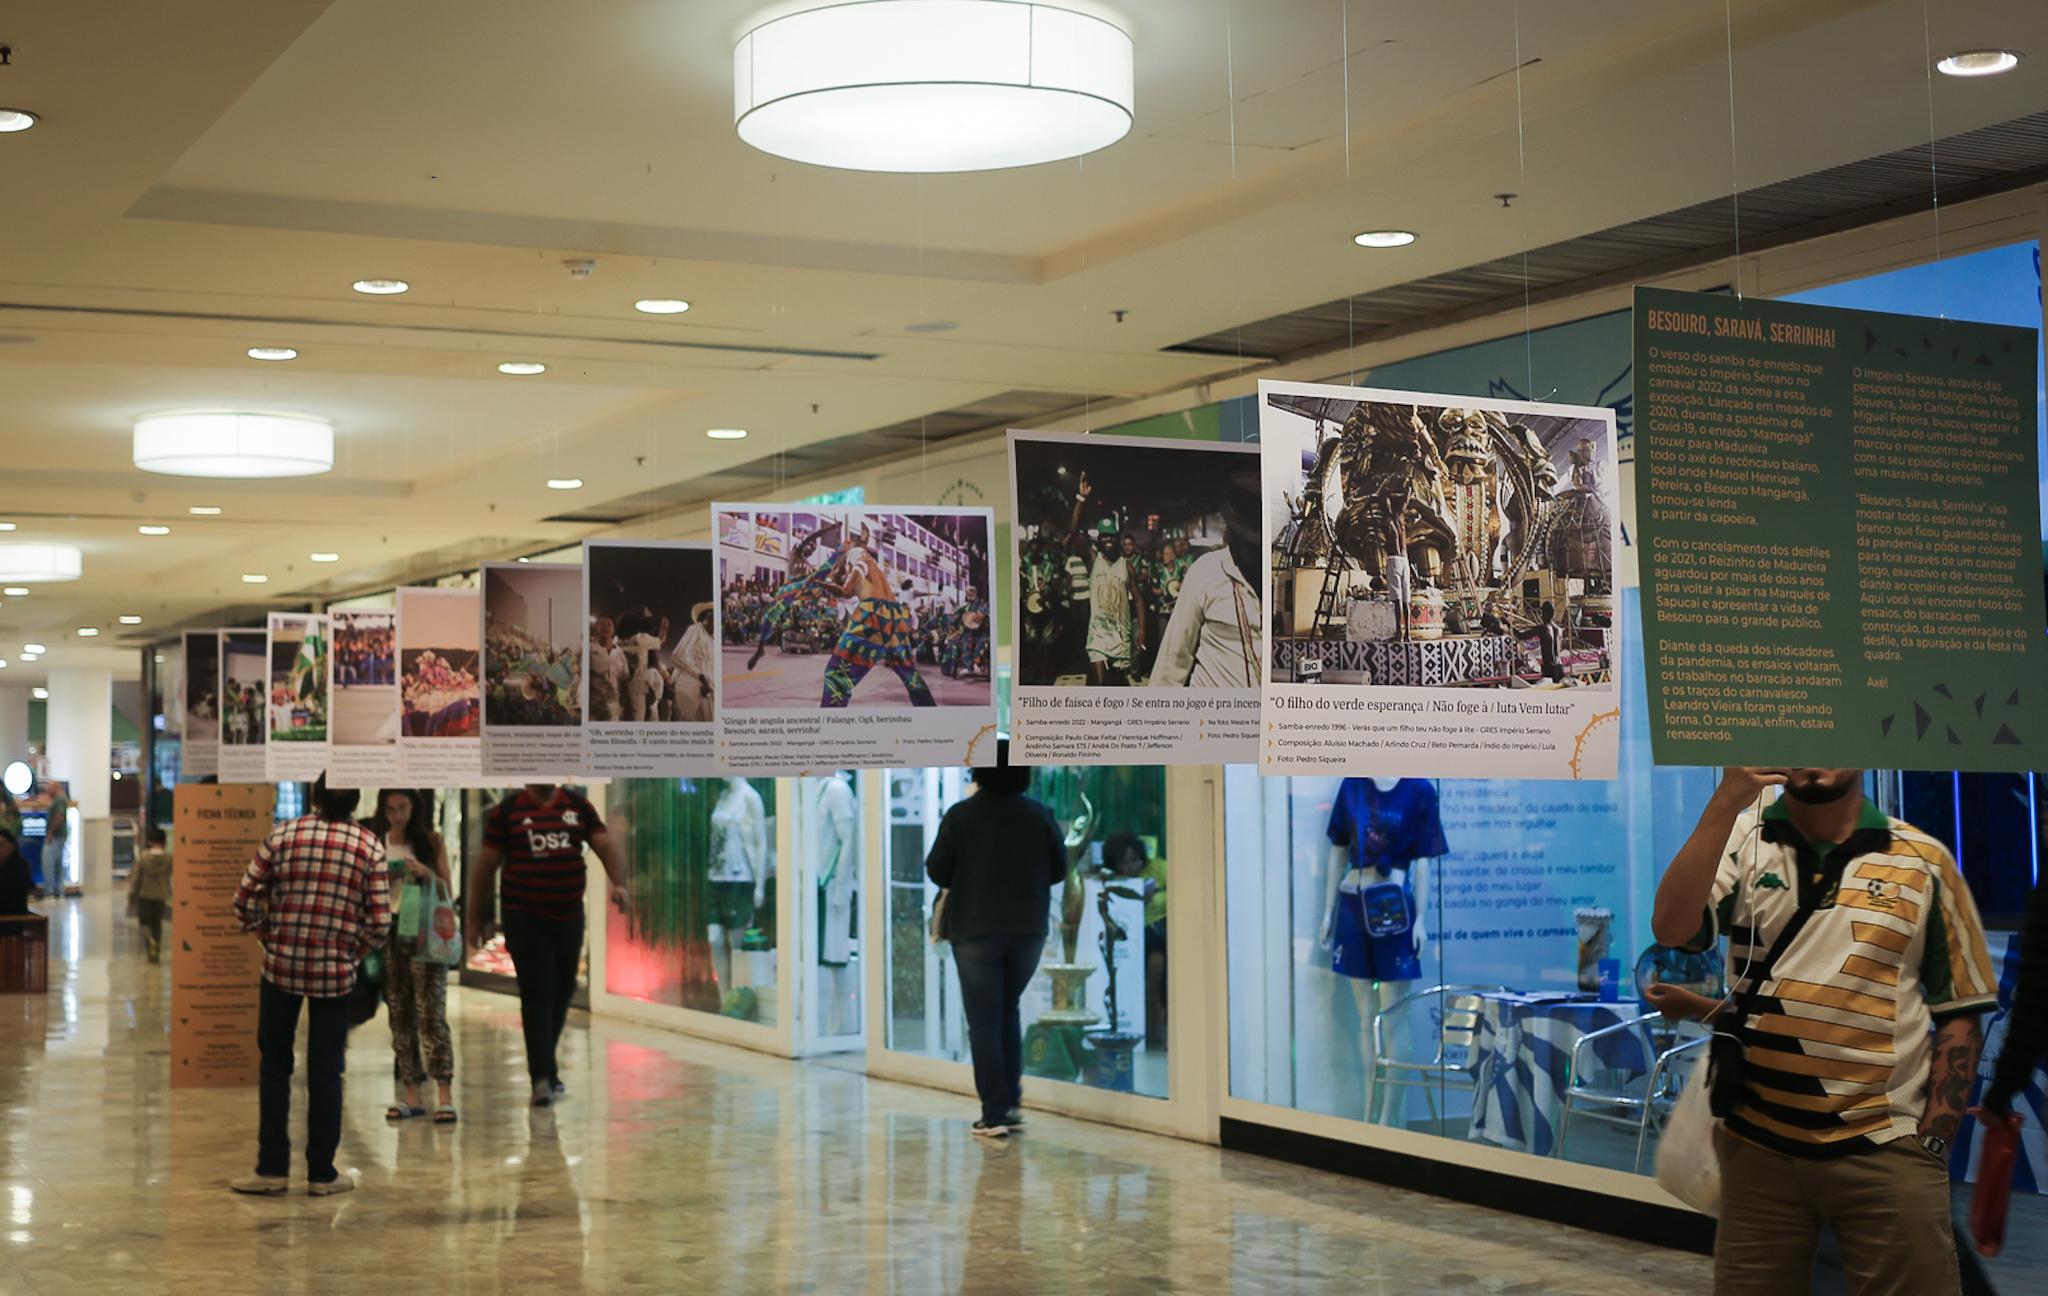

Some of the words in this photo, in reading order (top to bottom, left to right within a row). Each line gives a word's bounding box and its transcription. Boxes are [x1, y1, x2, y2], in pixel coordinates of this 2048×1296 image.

[1649, 310, 1711, 339] BESOURO,
[1715, 316, 1767, 344] SARAVÁ,
[1770, 321, 1836, 347] SERRINHA!
[1649, 346, 1658, 358] O
[1661, 350, 1690, 361] verso
[1692, 350, 1707, 363] do
[1709, 354, 1745, 366] samba
[1748, 355, 1761, 368] de
[1763, 359, 1801, 371] enredo
[1803, 363, 1823, 375] que
[1649, 363, 1697, 376] embalou
[1700, 368, 1707, 377] o
[1710, 366, 1751, 382] Império
[1754, 370, 1794, 385] Serrano
[1796, 377, 1810, 386] no
[1860, 592, 1884, 606] Aqui
[1886, 594, 1909, 605] você
[1912, 595, 1926, 606] vai
[1928, 597, 1975, 608] encontrar
[1978, 598, 2002, 610] fotos
[2004, 599, 2022, 611] dos
[1904, 607, 1917, 618] do
[1919, 608, 1962, 620] barracão
[1964, 612, 1981, 621] em
[1660, 639, 1696, 652] Diante
[1698, 641, 1712, 653] da
[1715, 642, 1749, 656] queda
[1752, 643, 1771, 655] dos
[1773, 644, 1834, 658] indicadores
[1863, 634, 1899, 648] desfile,
[1901, 636, 1914, 647] da
[1916, 638, 1962, 651] apuração
[1964, 641, 1970, 649] e
[1972, 639, 1985, 650] da
[1987, 639, 2011, 651] festa
[2013, 643, 2025, 652] na
[1660, 654, 1674, 666] da
[1678, 655, 1735, 669] pandemia,
[1737, 659, 1750, 668] os
[1752, 658, 1792, 670] ensaios
[1794, 659, 1843, 673] voltaram,
[1661, 671, 1674, 680] os
[1677, 669, 1728, 682] trabalhos
[1730, 673, 1744, 683] no
[1746, 671, 1793, 684] barracão
[1795, 673, 1842, 686] andaram
[1867, 676, 1888, 688] Axé!
[1662, 686, 1670, 695] e
[1672, 686, 1685, 695] os
[1687, 684, 1720, 699] traços
[1723, 685, 1737, 697] do
[1739, 687, 1808, 699] carnavalesco
[1050, 697, 1062, 707] de
[1065, 697, 1093, 708] faísca
[1095, 697, 1101, 708] é
[1103, 697, 1124, 710] fogo
[1132, 697, 1143, 708] Se
[1145, 697, 1170, 708] entra
[1173, 700, 1185, 708] no
[1187, 697, 1207, 710] jogo
[1208, 697, 1214, 708] é
[1216, 700, 1232, 710] pra
[1288, 697, 1313, 709] filho
[1316, 698, 1330, 710] do
[1333, 698, 1364, 711] verde
[1367, 702, 1423, 714] esperança
[1433, 700, 1454, 712] Não
[1457, 700, 1479, 716] foge
[1497, 701, 1517, 714] luta
[1519, 702, 1542, 714] Vem
[1664, 698, 1709, 711] Leandro
[1711, 699, 1742, 712] Vieira
[1744, 700, 1776, 713] foram
[1778, 702, 1832, 716] ganhando
[748, 715, 758, 725] de
[760, 715, 785, 727] angola
[786, 715, 820, 724] ancestral
[876, 714, 912, 723] berimbau
[1665, 712, 1702, 725] forma.
[1703, 713, 1713, 725] O
[1715, 715, 1763, 728] carnaval,
[1801, 716, 1834, 729] estava
[724, 725, 758, 735] Besouro,
[787, 724, 821, 734] serrinha!
[1667, 728, 1734, 740] renascendo.
[1296, 755, 1317, 763] Pedro
[1318, 755, 1346, 765] Siqueira
[528, 829, 572, 851] bs2
[1455, 929, 1468, 939] de
[1471, 930, 1500, 941] quem
[1504, 927, 1524, 938] vive
[1527, 929, 1534, 937] o
